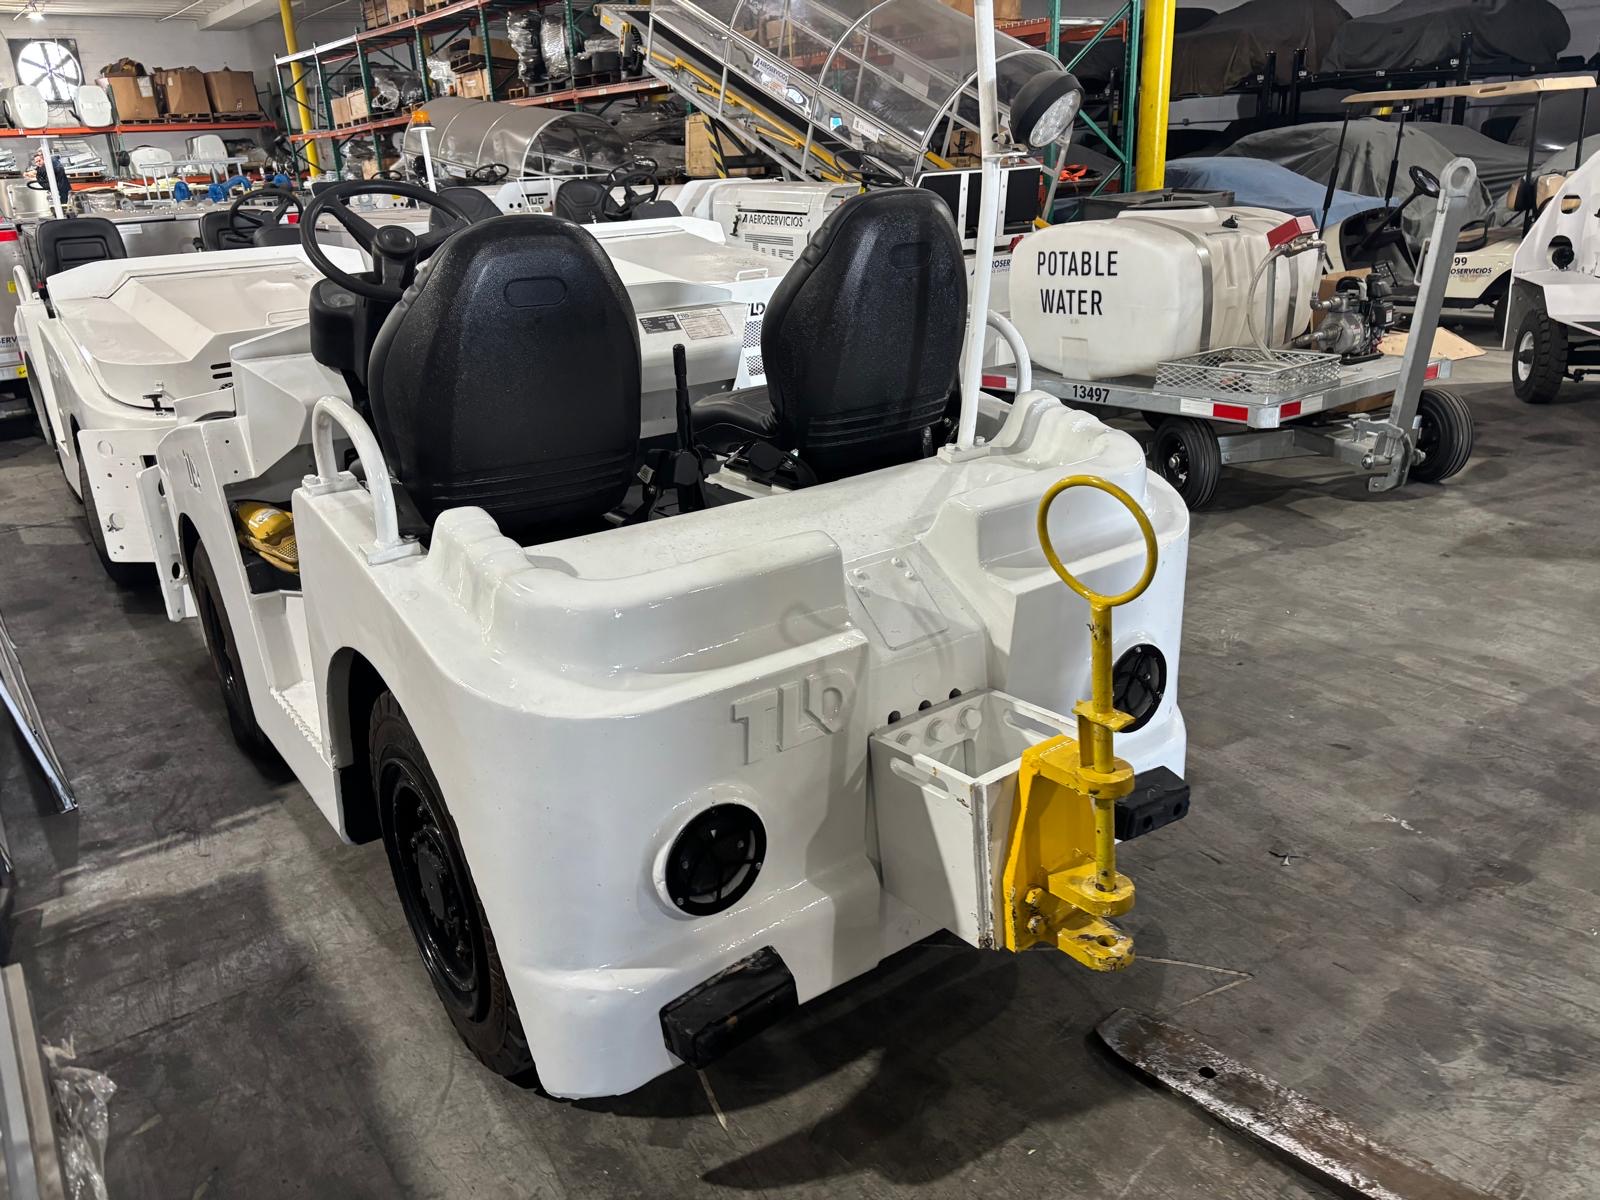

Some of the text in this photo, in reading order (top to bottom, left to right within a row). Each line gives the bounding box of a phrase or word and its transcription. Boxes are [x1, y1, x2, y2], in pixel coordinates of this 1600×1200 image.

[749, 213, 803, 227] AEROSERVICIOS
[1037, 250, 1118, 276] POTABLE
[1450, 267, 1492, 275] OSERVICIOS
[748, 302, 766, 316] LD
[1040, 288, 1102, 315] WATER
[1072, 384, 1110, 403] 13497
[730, 667, 857, 766] TLD
